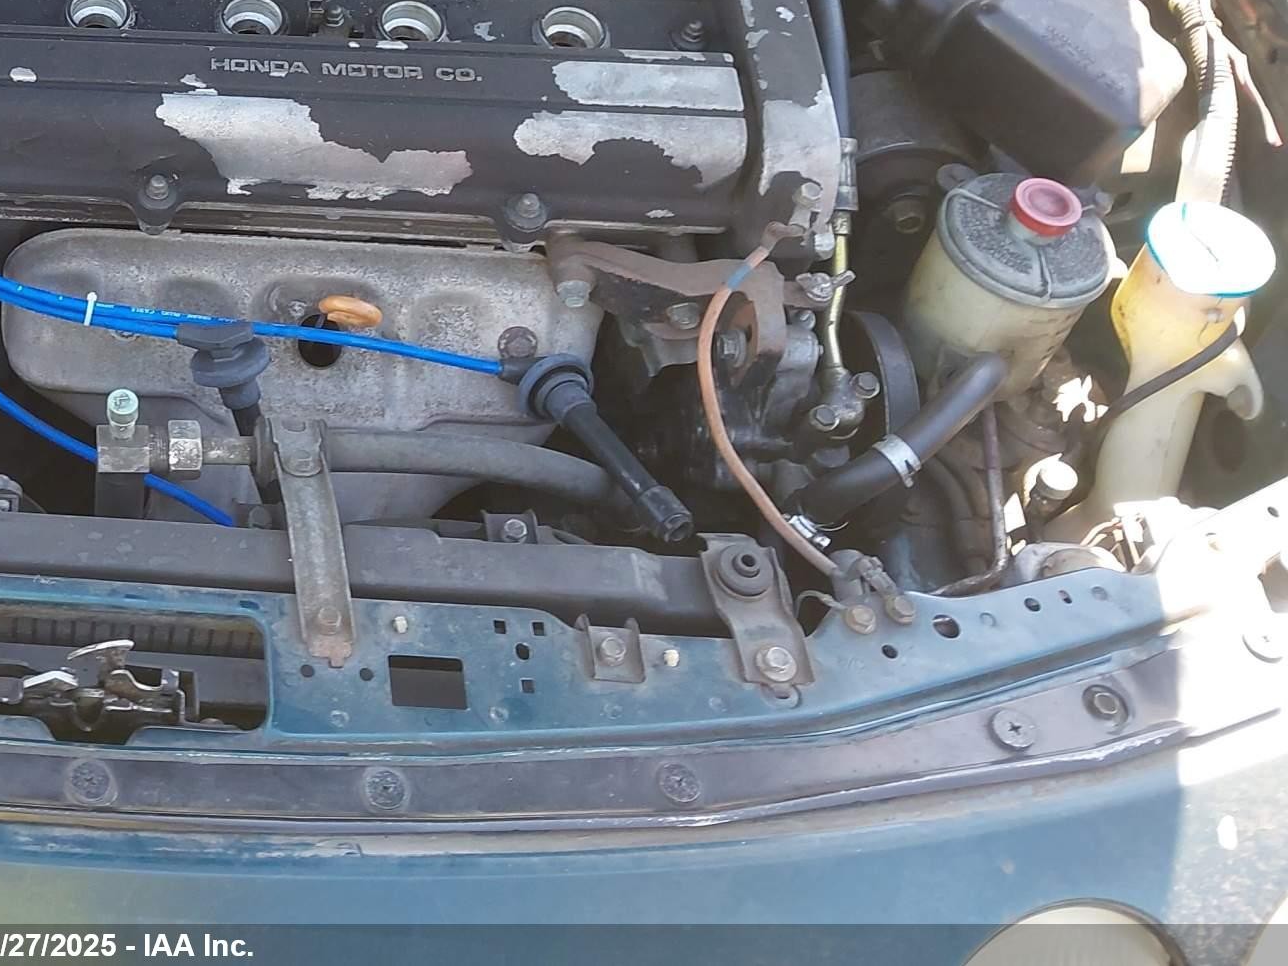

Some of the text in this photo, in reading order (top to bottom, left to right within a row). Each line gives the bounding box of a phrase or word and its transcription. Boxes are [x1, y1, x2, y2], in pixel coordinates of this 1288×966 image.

[210, 58, 482, 82] HONDA MOTOR CO.
